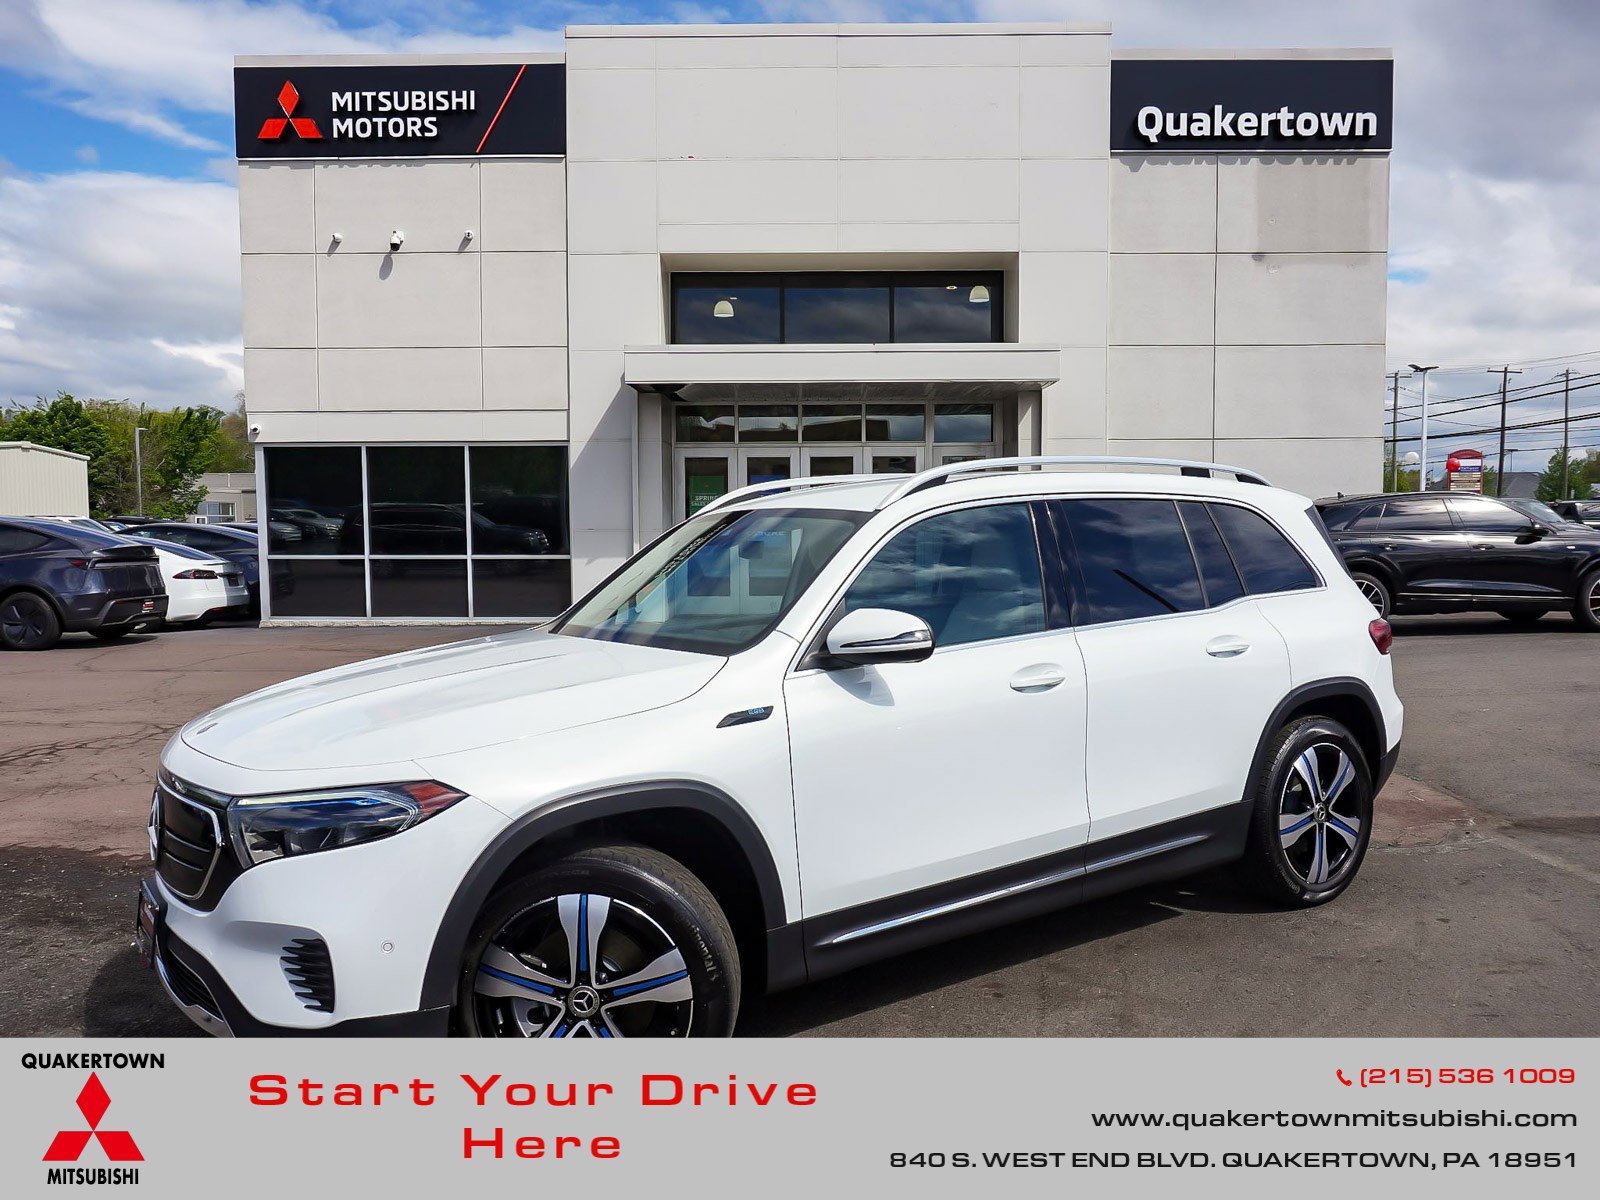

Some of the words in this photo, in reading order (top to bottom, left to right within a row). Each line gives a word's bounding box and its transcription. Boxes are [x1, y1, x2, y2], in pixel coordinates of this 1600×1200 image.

[331, 89, 475, 112] MITSUBISHI
[332, 116, 438, 139] MOTORS
[1137, 104, 1378, 143] Quakertown
